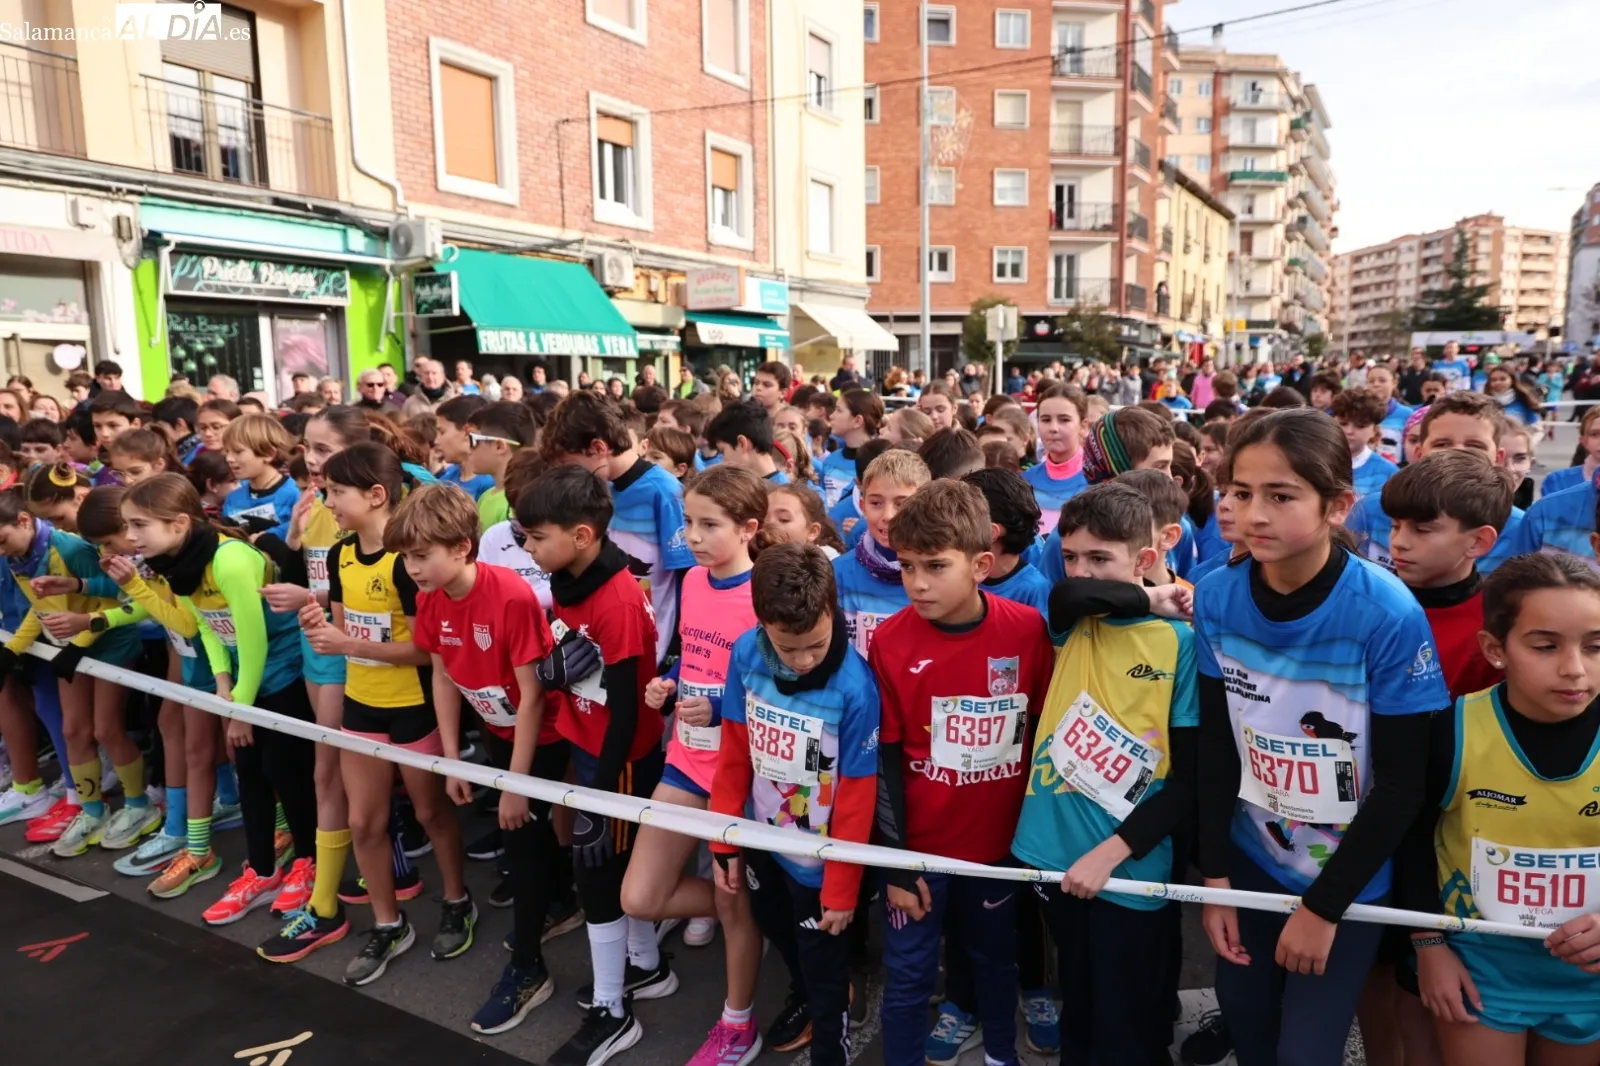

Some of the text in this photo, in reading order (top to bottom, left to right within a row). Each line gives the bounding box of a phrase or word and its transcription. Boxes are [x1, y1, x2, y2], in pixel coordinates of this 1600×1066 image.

[479, 330, 527, 353] FRUTAS
[529, 332, 539, 353] &
[540, 333, 600, 355] VERDURAS
[603, 336, 637, 358] VERA
[960, 697, 1019, 714] SETEL
[755, 706, 811, 733] SETEL
[945, 714, 1006, 747] 6397
[1063, 717, 1132, 784] 6349
[1093, 714, 1149, 763] SETEL
[1255, 734, 1338, 757] SETEL
[956, 761, 1022, 787] RURAL
[1248, 746, 1319, 795] 6370
[1476, 790, 1517, 804] ALJOMAR
[1514, 852, 1600, 869] SETE
[1498, 868, 1586, 908] 6510
[1528, 907, 1554, 915] VEGA
